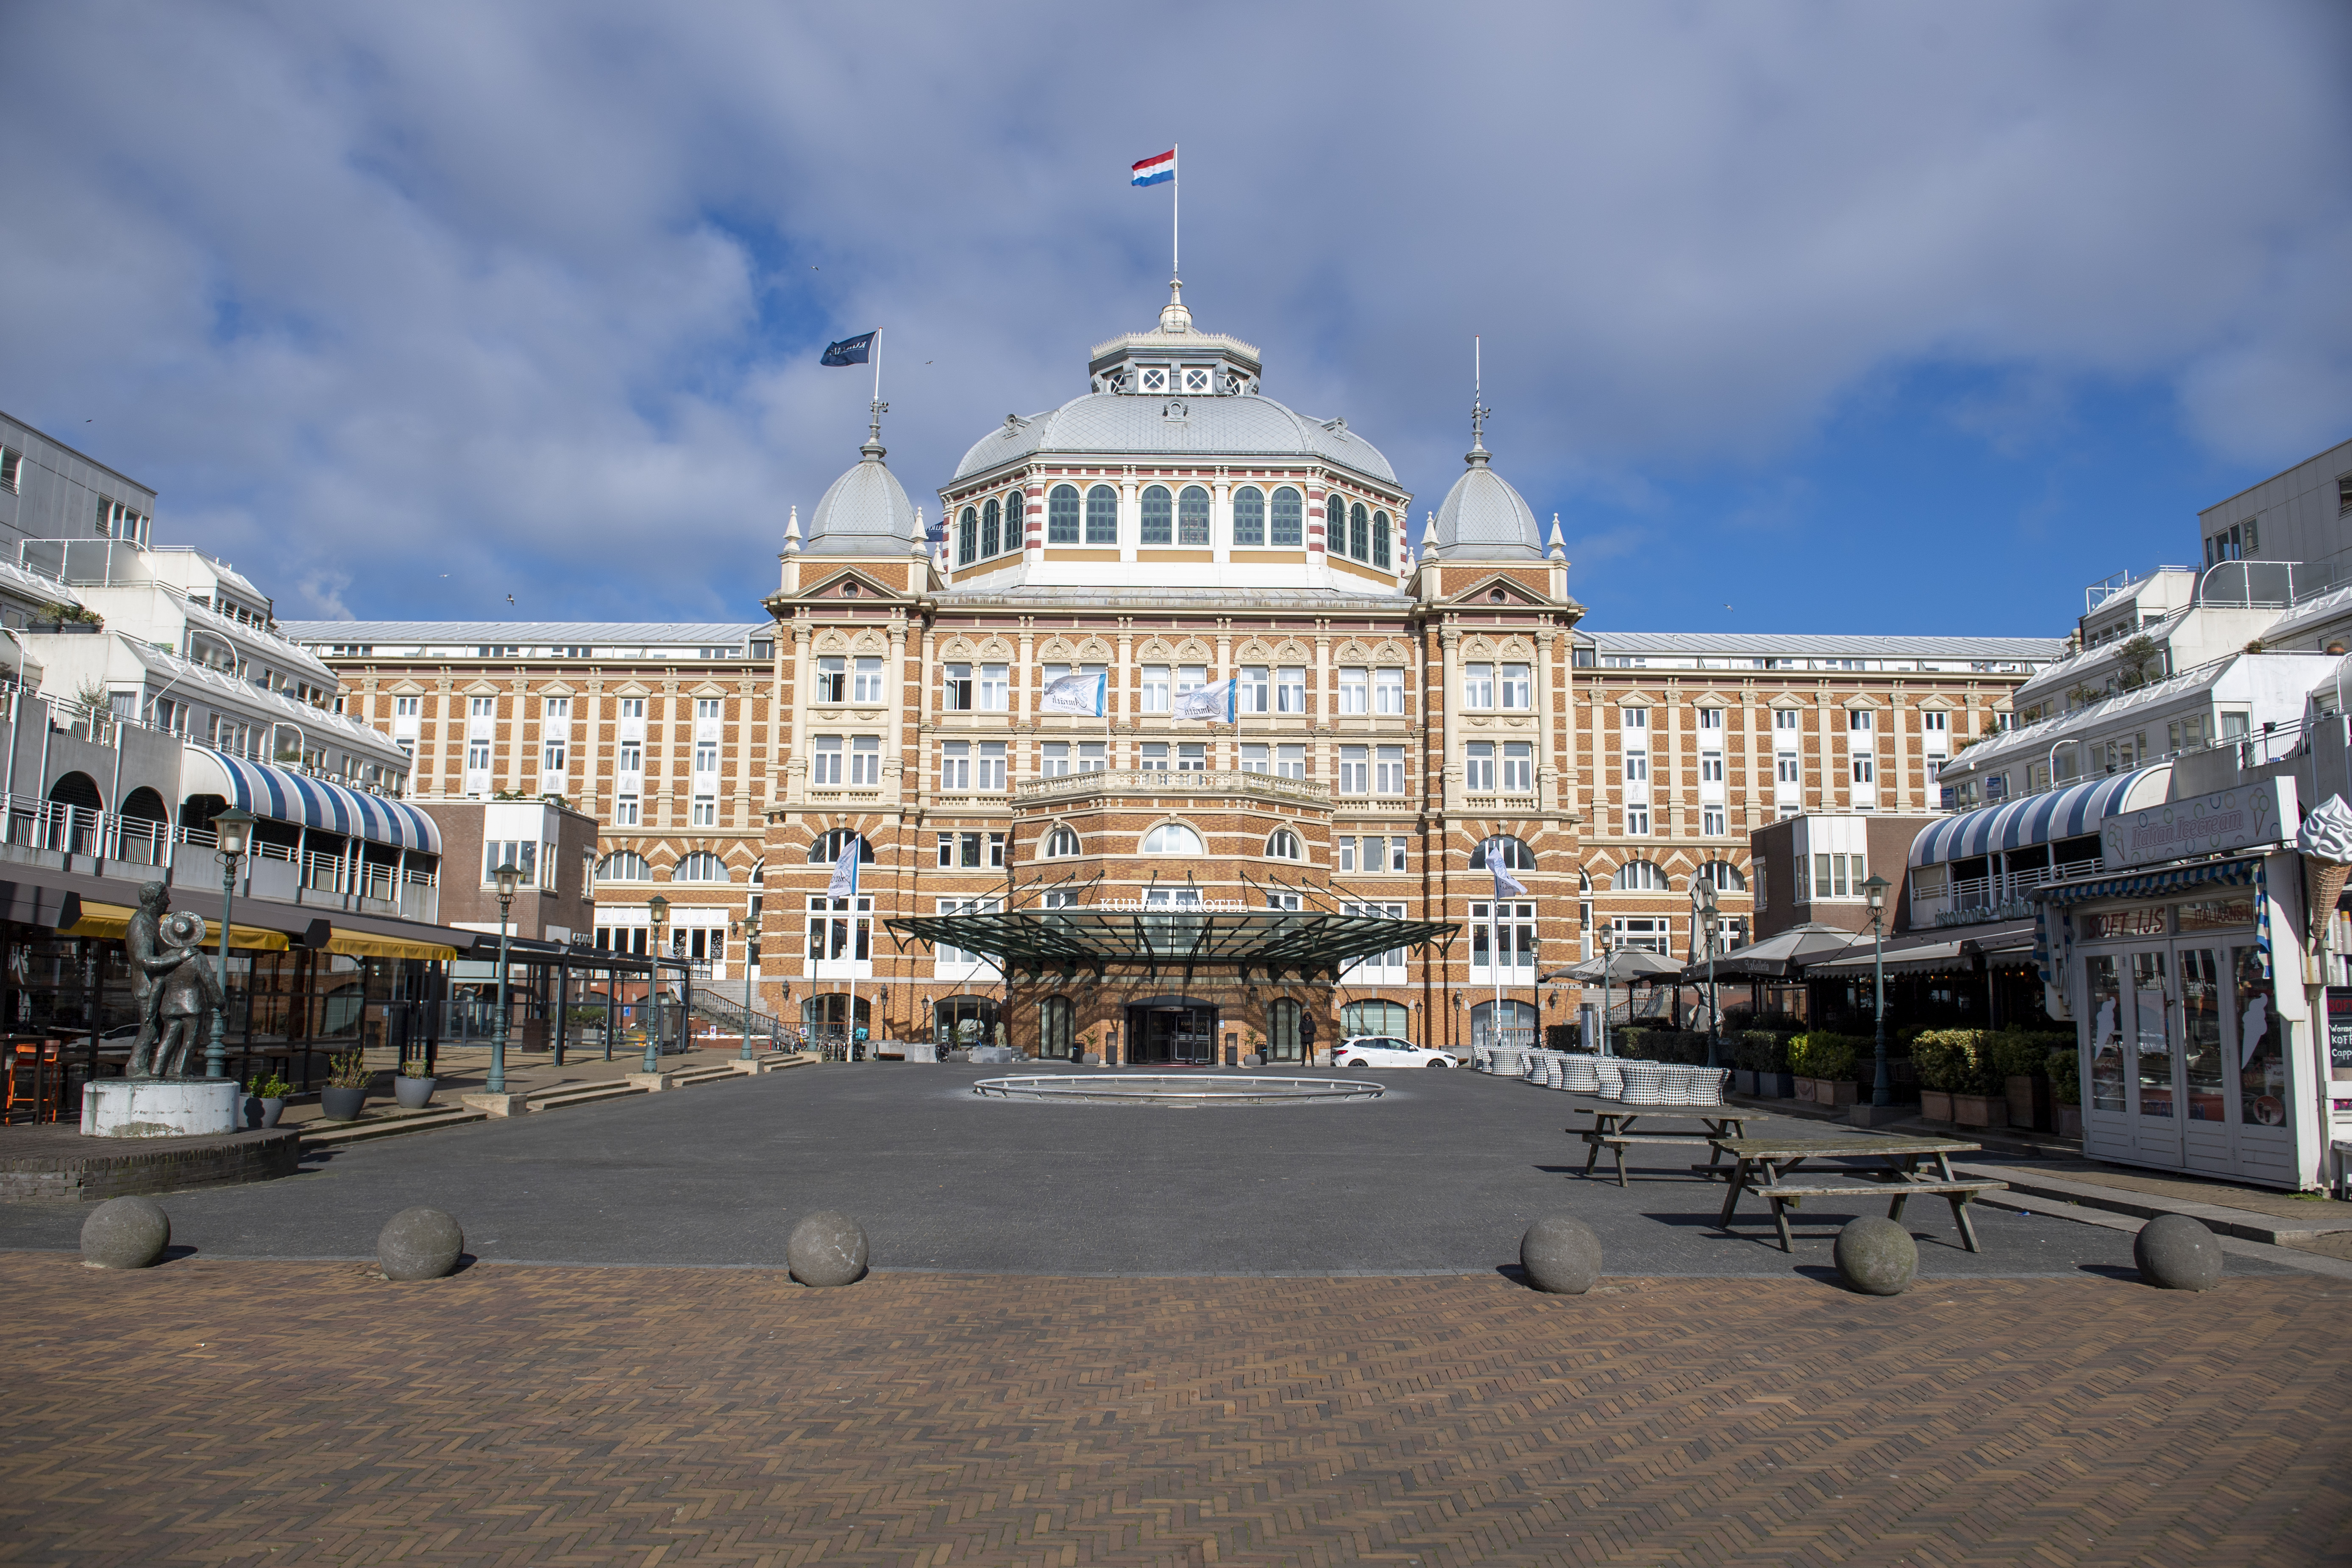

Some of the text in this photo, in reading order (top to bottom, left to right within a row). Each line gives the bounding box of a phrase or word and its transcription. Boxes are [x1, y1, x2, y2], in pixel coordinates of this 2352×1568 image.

[2132, 810, 2243, 850] Italian Icecream
[1099, 898, 1248, 913] KURHAUS HOTEL
[2195, 905, 2242, 923] ITALIAANS
[1935, 906, 1988, 927] ristorante
[2089, 908, 2165, 939] SOFT IJS
[1694, 967, 1701, 976] La
[1745, 960, 1769, 971] La Galleria
[2243, 1063, 2263, 1089] SOFT
